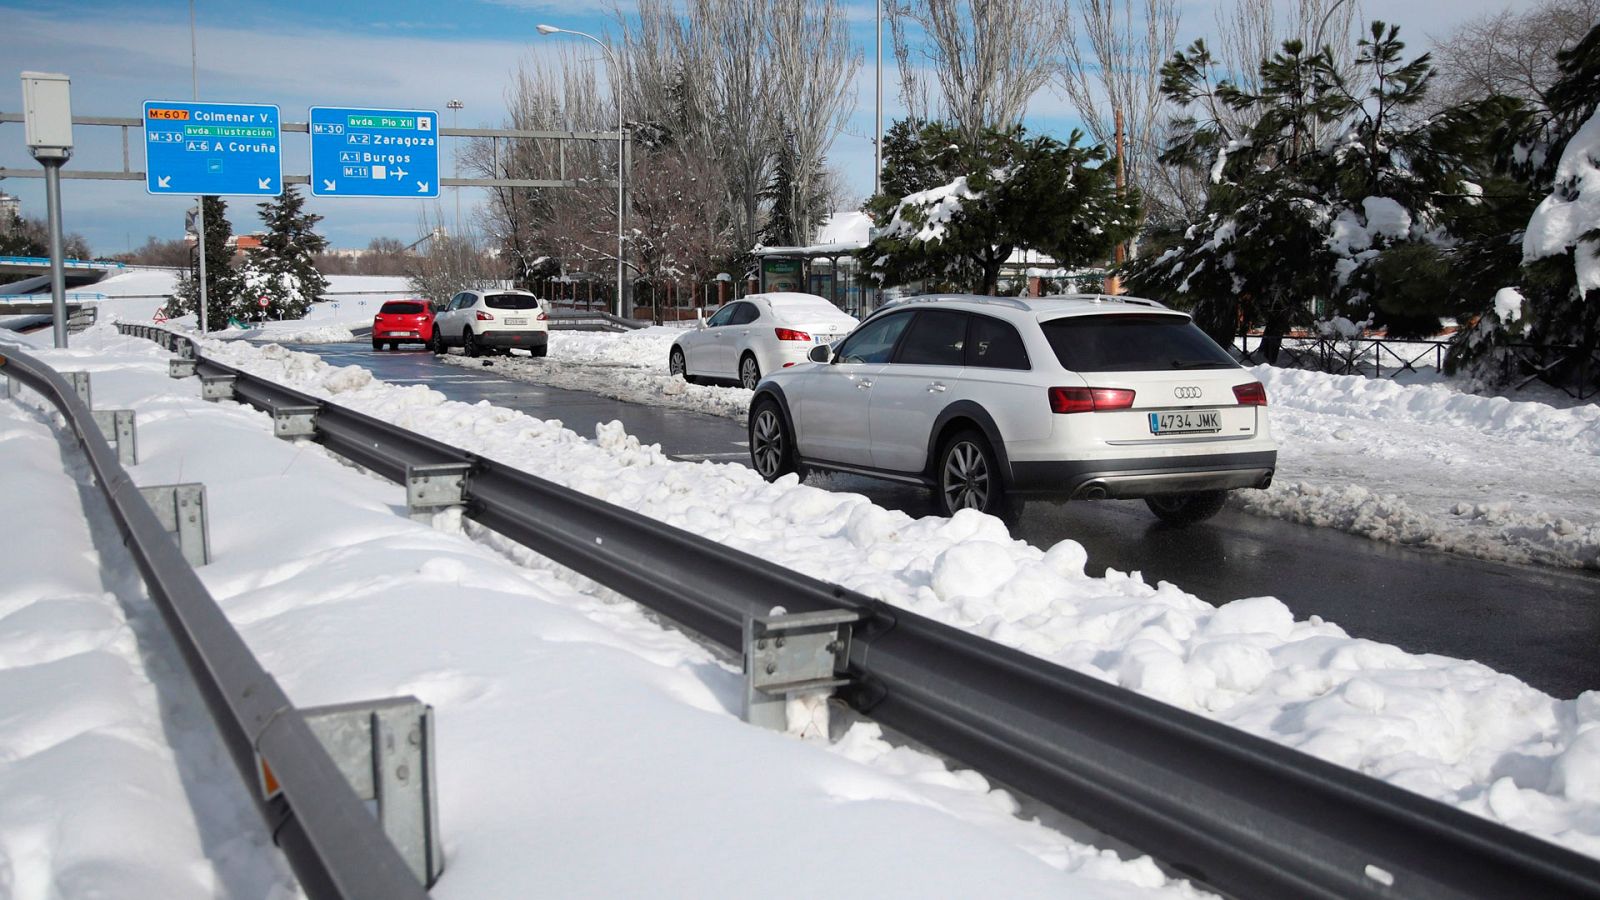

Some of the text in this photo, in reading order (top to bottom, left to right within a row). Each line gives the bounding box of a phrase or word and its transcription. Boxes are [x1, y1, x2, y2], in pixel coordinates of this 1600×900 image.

[149, 110, 273, 123] M-607 Colmenar V.
[350, 118, 376, 126] avda.
[186, 127, 272, 136] avda. Ilustración
[314, 125, 343, 134] M-30
[150, 132, 182, 142] M-30
[349, 135, 434, 147] A-2 Zaragoza
[188, 142, 276, 153] A-6 A Coruña
[342, 153, 411, 164] A-1 Burgos
[345, 167, 367, 176] M-11
[1160, 413, 1218, 429] 4734 JMK
